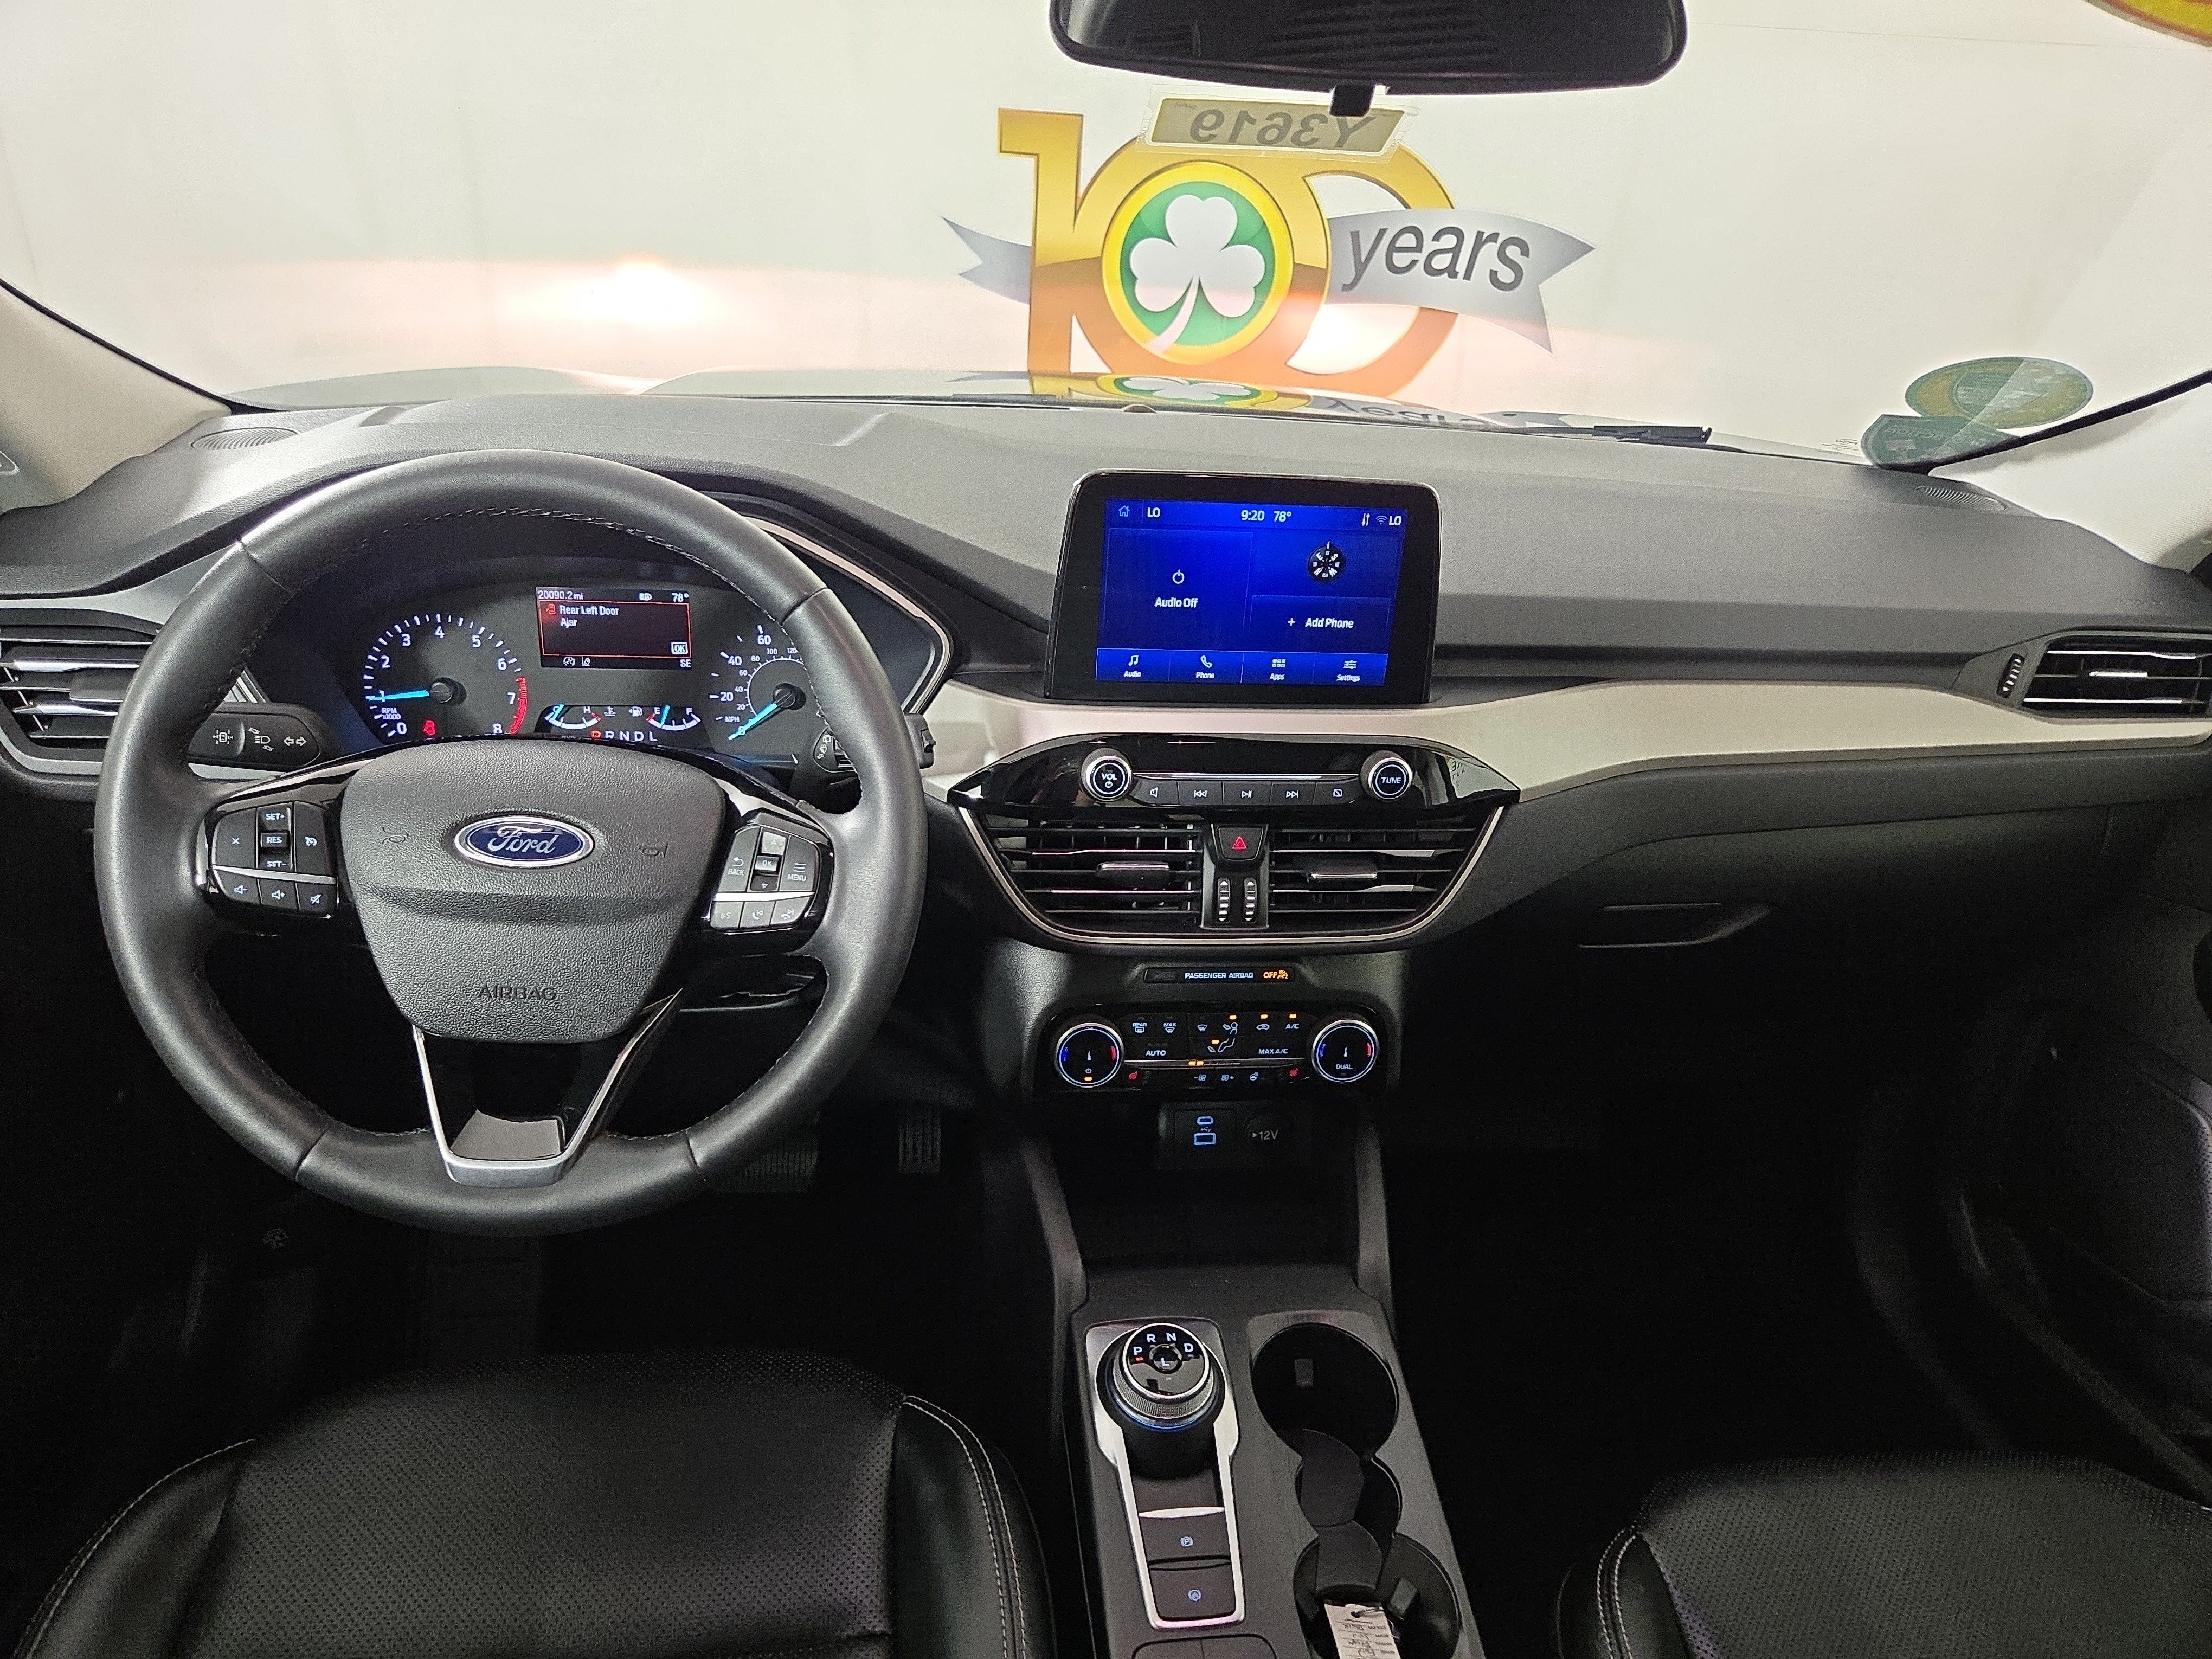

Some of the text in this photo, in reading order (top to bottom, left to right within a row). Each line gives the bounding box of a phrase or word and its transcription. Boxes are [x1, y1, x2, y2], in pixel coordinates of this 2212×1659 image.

[1342, 224, 1531, 293] years
[1147, 507, 1161, 518] LO
[1241, 510, 1292, 522] 9:20 78°
[1389, 515, 1402, 526] LO
[538, 590, 573, 600] 20090.2
[672, 593, 689, 602] 78°
[1154, 597, 1198, 608] Audio Off
[560, 605, 619, 616] Rear Left Door
[561, 618, 578, 628] Ajar
[1305, 617, 1354, 629] Add Phone
[435, 625, 444, 638] 4
[402, 634, 411, 646] 3
[472, 635, 481, 647] 5
[757, 635, 771, 645] 60
[674, 644, 685, 653] OK
[382, 655, 391, 668] 2
[497, 658, 507, 670] 6
[680, 659, 692, 668] SE
[728, 656, 742, 666] 40
[1124, 670, 1141, 678] Audio
[1196, 671, 1214, 679] Phone
[1270, 673, 1285, 681] Apps
[1336, 674, 1360, 684] Settings
[507, 692, 516, 704] 7
[720, 692, 734, 702] 20
[397, 722, 407, 735] 0
[493, 723, 502, 734] 8
[605, 731, 614, 740] R
[620, 732, 629, 741] N
[635, 732, 644, 741] D
[649, 732, 658, 742] L
[1102, 773, 1118, 781] VOL
[1381, 776, 1401, 785] TUNE
[488, 825, 558, 854] Ford
[728, 868, 745, 876] BACK
[788, 873, 807, 882] MENU
[478, 983, 557, 1001] AIRBAG
[1259, 1130, 1278, 1140] 12V
[1147, 1332, 1176, 1343] R N
[1133, 1346, 1142, 1356] P
[1184, 1343, 1194, 1353] D
[1161, 1357, 1169, 1366] L
